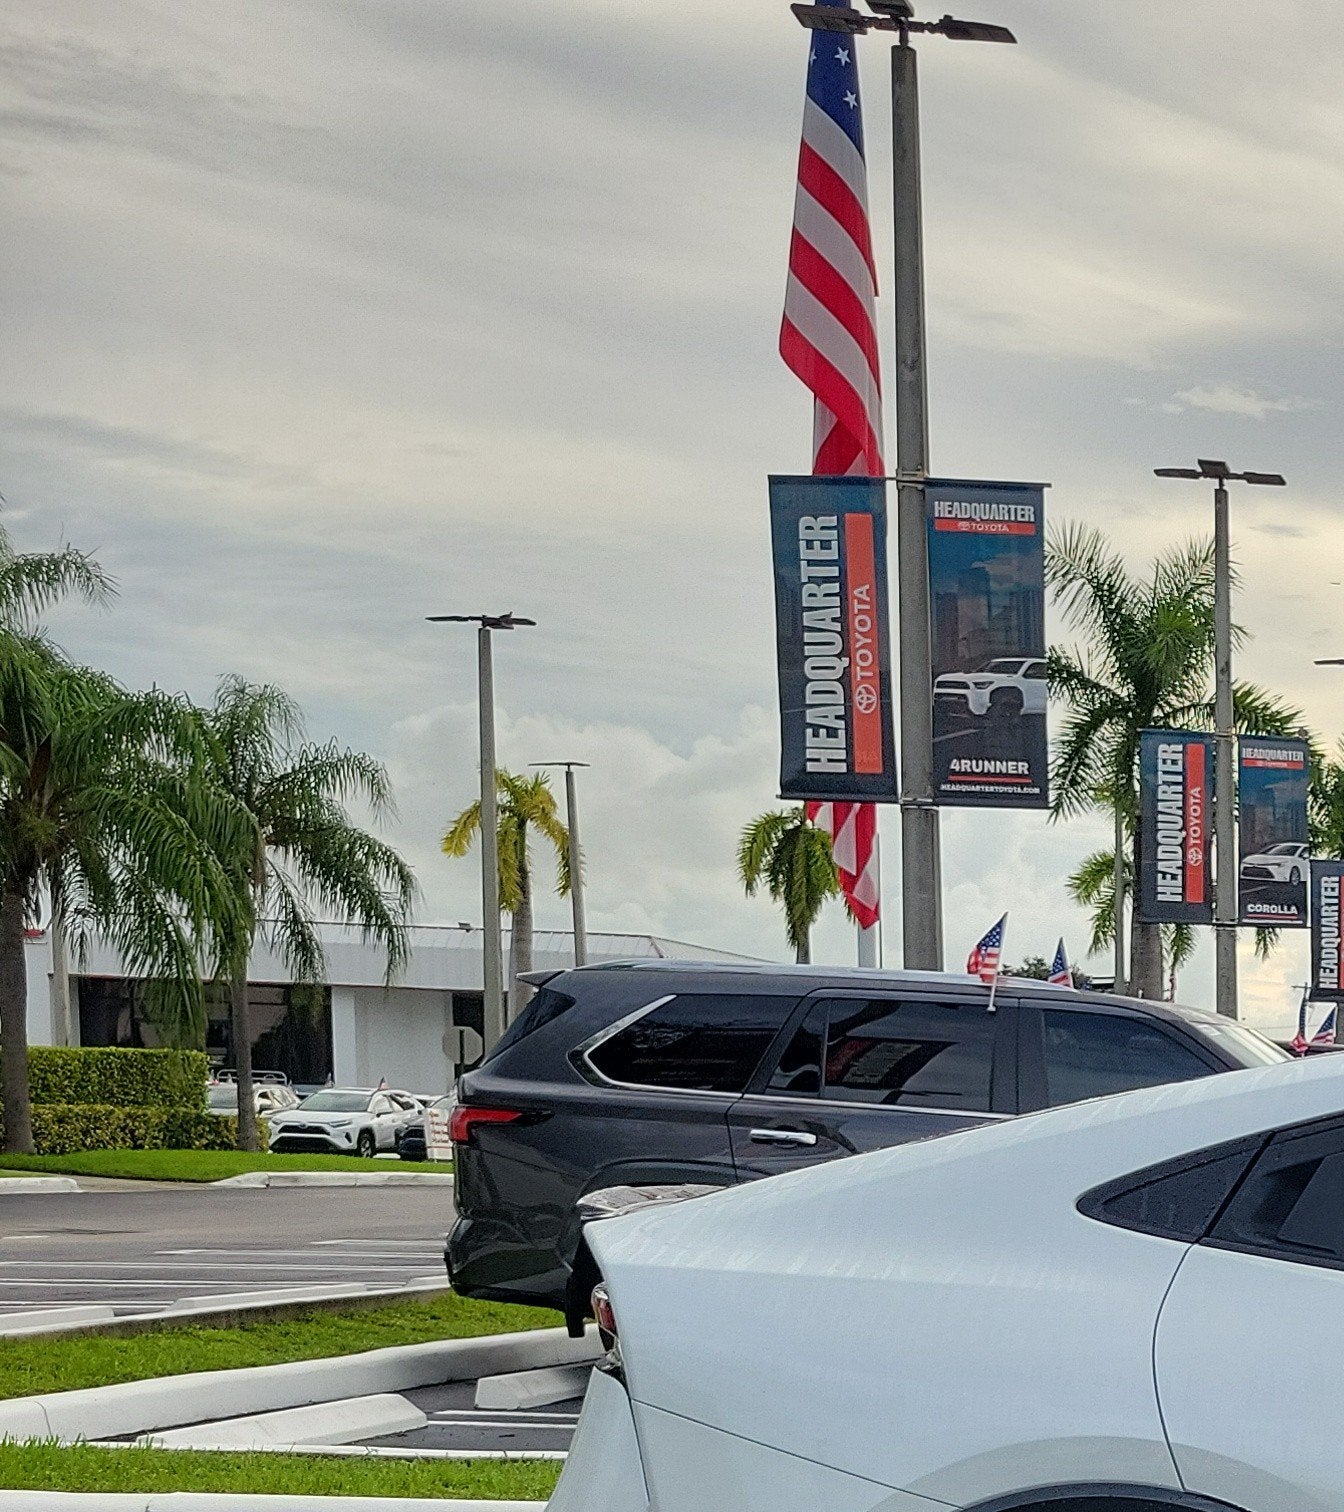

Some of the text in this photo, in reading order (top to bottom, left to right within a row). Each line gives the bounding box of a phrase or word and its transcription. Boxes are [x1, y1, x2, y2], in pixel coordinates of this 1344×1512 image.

[934, 501, 1036, 522] HEADQUARTER
[972, 522, 1010, 533] TOYOTA
[798, 514, 850, 775] HEADQUARTER
[853, 583, 874, 679] TOYOTA
[949, 758, 1030, 775] 4RUNNER
[1242, 747, 1304, 761] HEADQUARTER
[1157, 743, 1187, 902] HEADQUARTER
[1190, 787, 1202, 844] TOYOTA
[1247, 903, 1299, 915] COROLLA
[1319, 876, 1341, 989] HEADQUARTER
